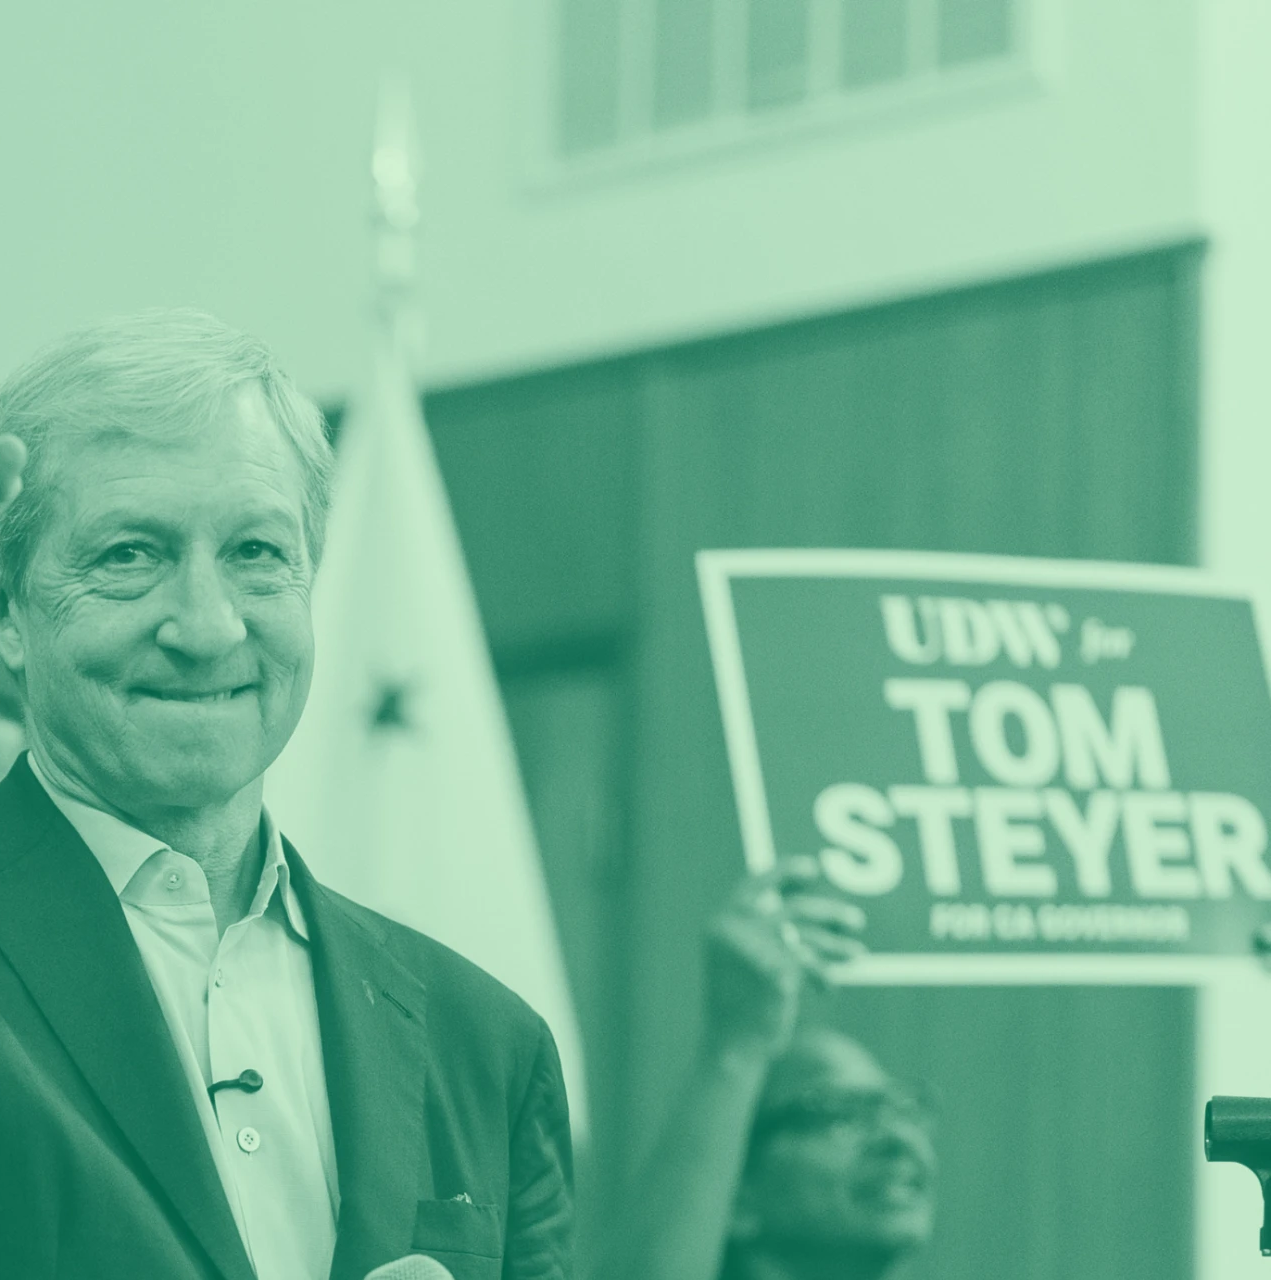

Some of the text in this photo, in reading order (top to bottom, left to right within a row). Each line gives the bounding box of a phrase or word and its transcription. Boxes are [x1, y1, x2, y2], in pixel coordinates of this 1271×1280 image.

[880, 594, 1071, 670] UDW
[882, 677, 1172, 791] TOM
[813, 782, 1271, 899] STEYER
